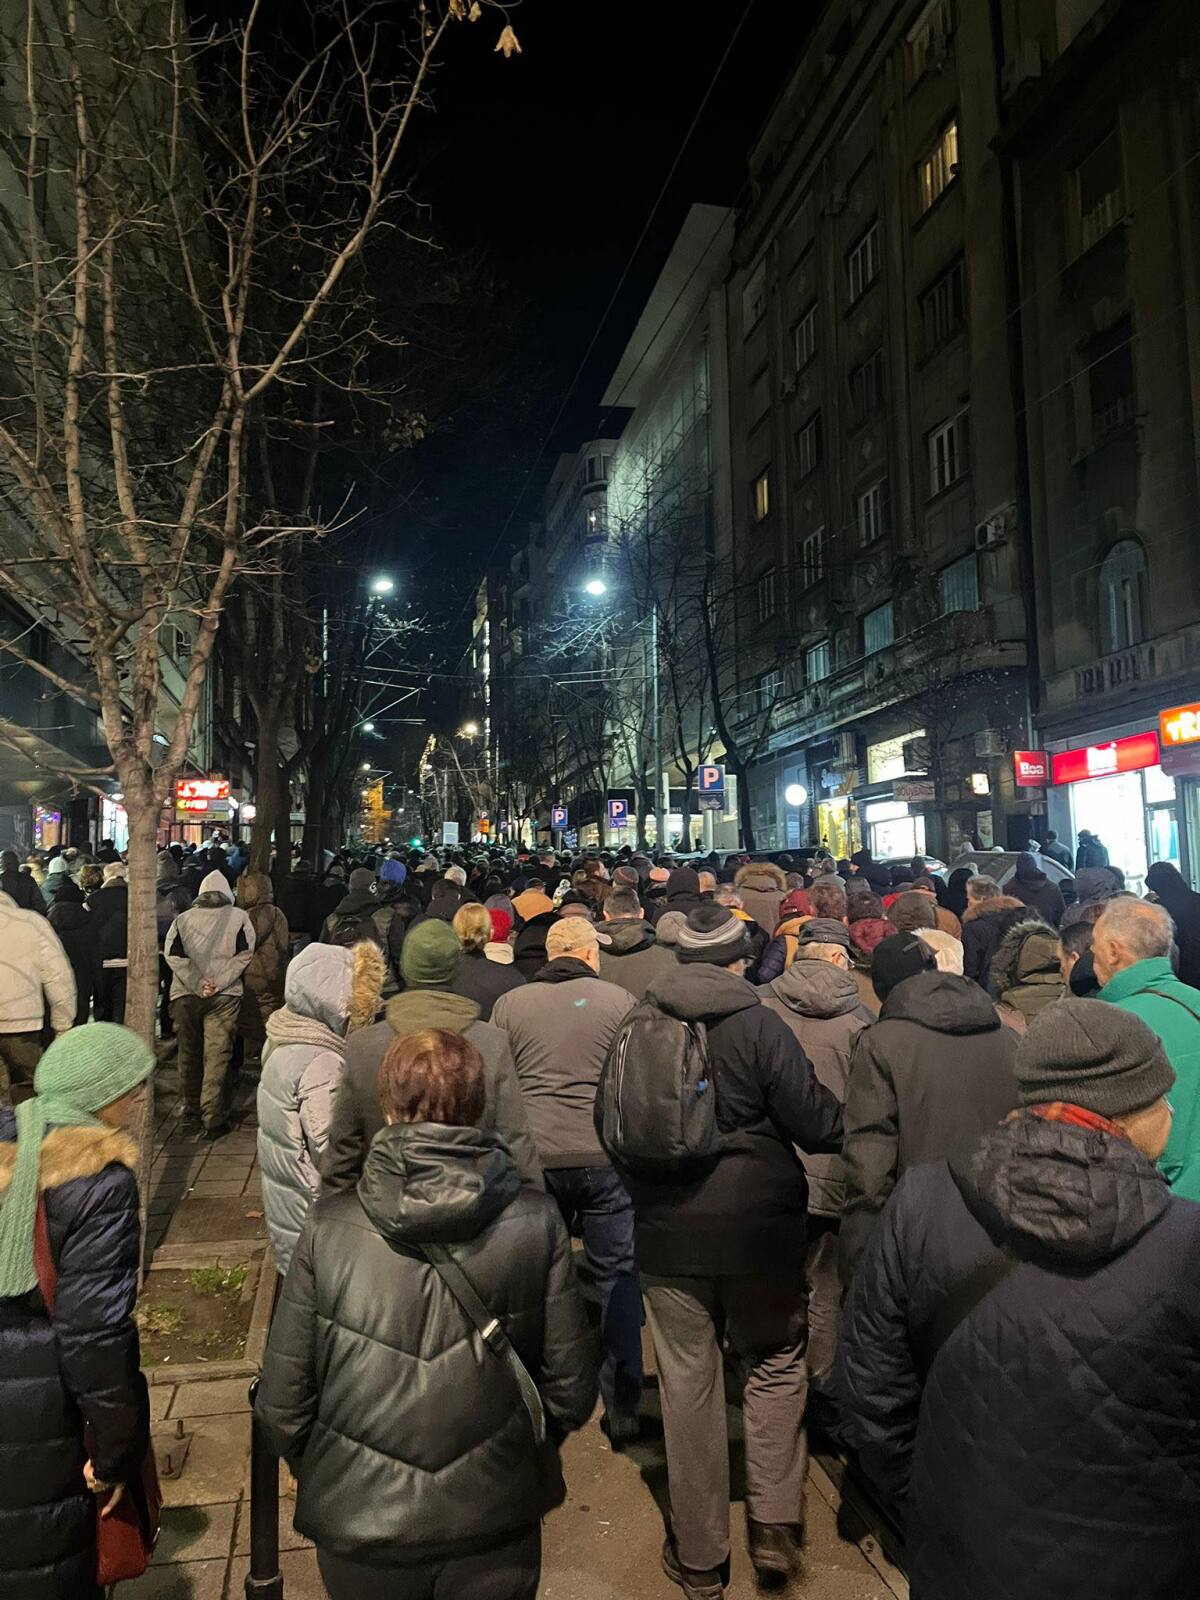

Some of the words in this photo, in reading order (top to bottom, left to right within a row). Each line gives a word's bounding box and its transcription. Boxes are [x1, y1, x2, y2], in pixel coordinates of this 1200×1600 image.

[704, 768, 719, 788] P
[482, 811, 488, 819] P
[612, 802, 623, 817] P
[554, 811, 565, 823] P
[500, 821, 507, 829] P
